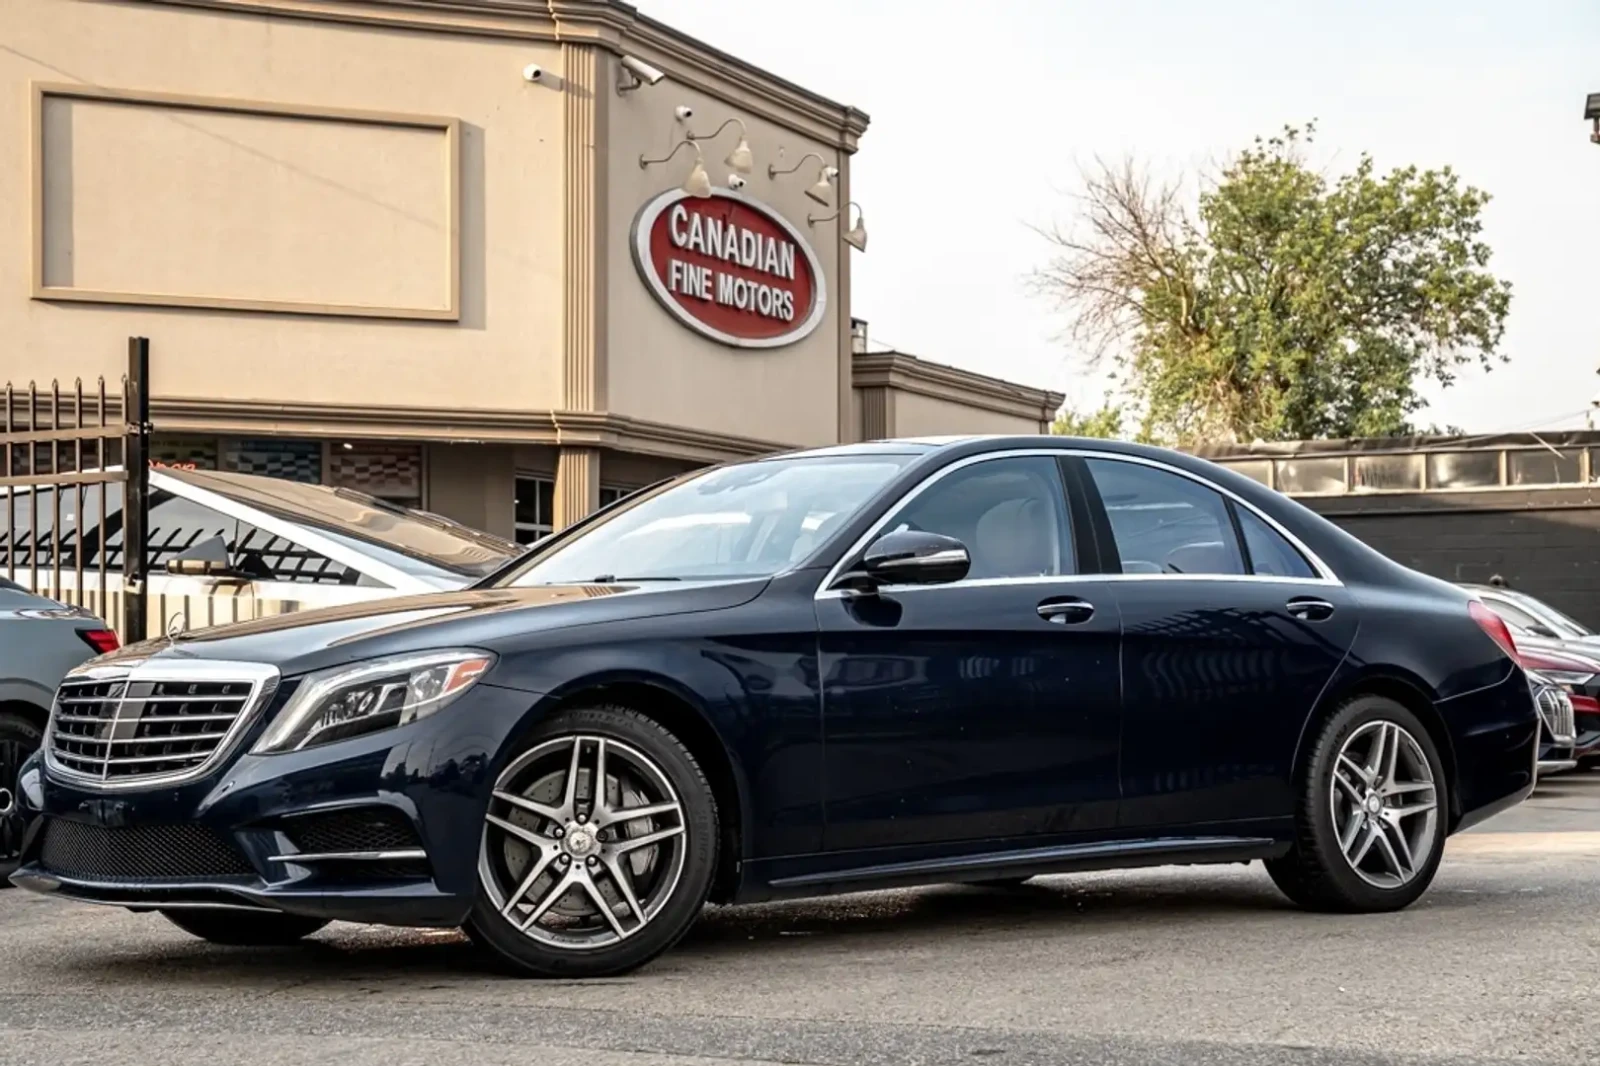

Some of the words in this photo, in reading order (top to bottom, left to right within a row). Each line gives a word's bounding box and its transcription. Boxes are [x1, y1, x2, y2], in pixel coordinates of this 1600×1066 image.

[670, 203, 796, 281] CANADIAN
[669, 259, 714, 301] FINE
[718, 272, 795, 322] MOTORS
